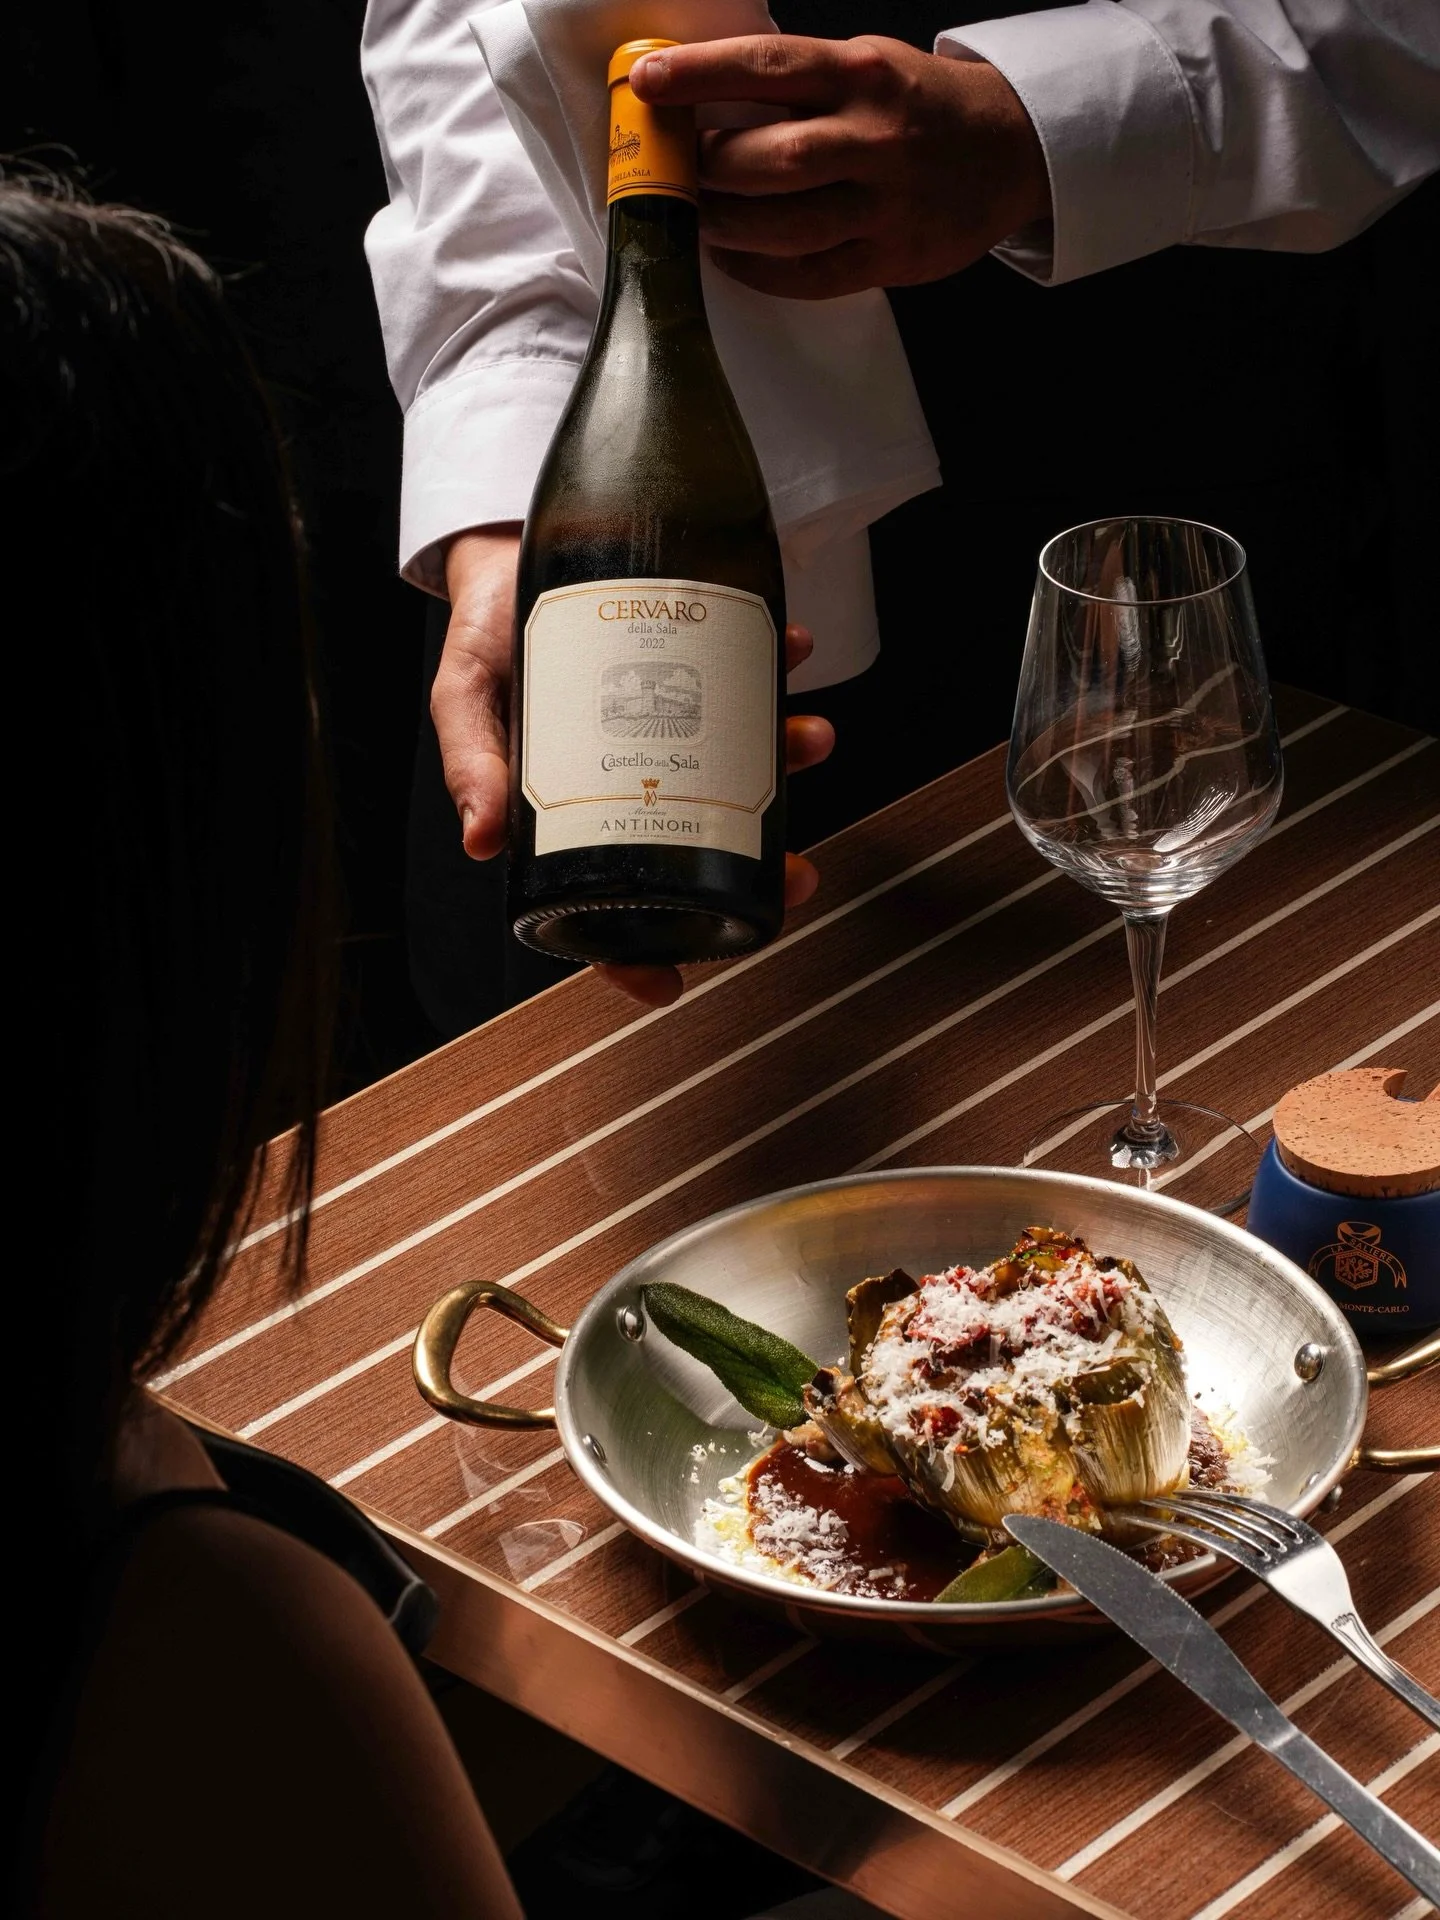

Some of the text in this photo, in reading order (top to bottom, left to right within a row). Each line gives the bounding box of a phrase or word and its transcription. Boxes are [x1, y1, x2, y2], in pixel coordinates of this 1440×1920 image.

[632, 167, 651, 177] SALA
[598, 600, 707, 622] CERVARO
[627, 622, 677, 635] della Sala
[639, 637, 665, 649] 2022
[601, 752, 700, 773] Castello della Sala
[600, 818, 700, 834] ANTINORI
[1331, 1245, 1343, 1254] LA
[1340, 1302, 1409, 1313] MONTE-CARLO
